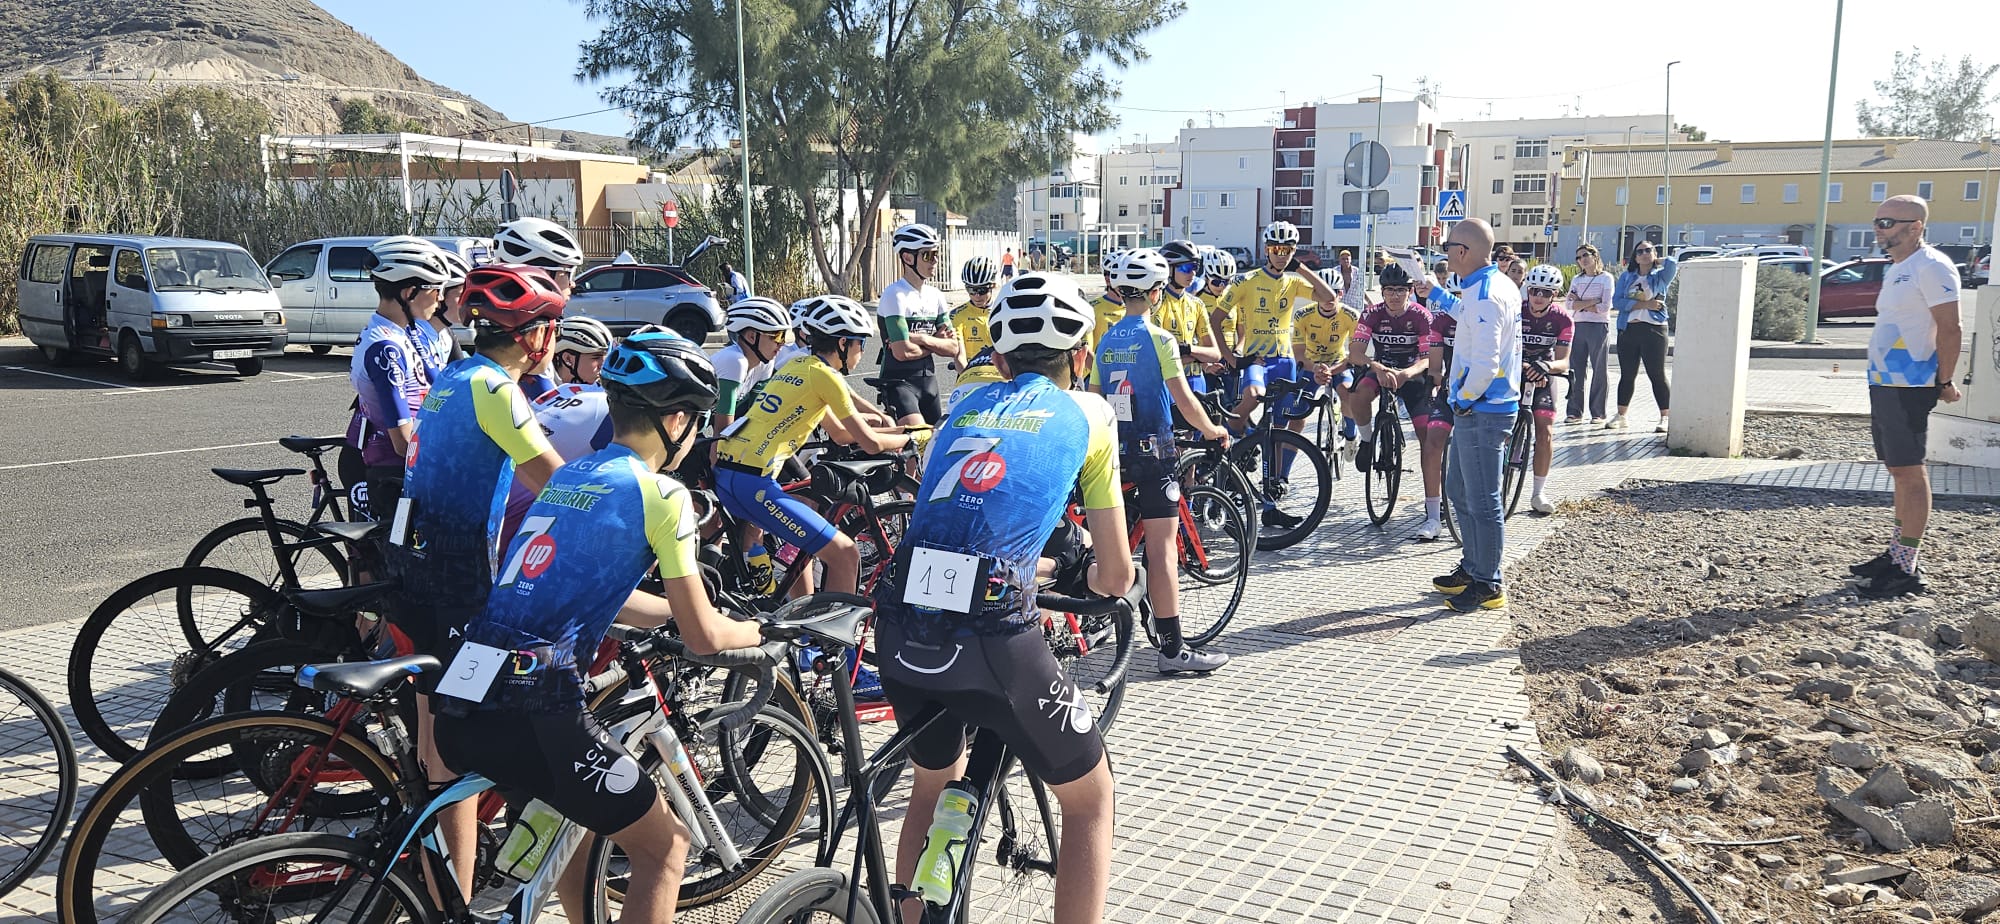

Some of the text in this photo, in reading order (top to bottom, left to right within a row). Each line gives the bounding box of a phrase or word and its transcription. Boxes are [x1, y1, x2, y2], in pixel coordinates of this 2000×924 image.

[1111, 327, 1138, 337] ACIC
[1378, 335, 1407, 344] TARO
[546, 396, 583, 410] TOP
[755, 440, 770, 457] Islas
[766, 413, 798, 440] Canarias
[568, 460, 614, 472] ACIC
[929, 437, 1003, 502] 7
[959, 495, 984, 505] ZERO
[763, 499, 807, 538] cajasiete
[499, 516, 556, 587] 7
[517, 581, 535, 591] ZERO
[919, 564, 958, 595] 19
[459, 659, 479, 681] 3
[859, 711, 888, 720] BH
[574, 731, 609, 772] ACIC
[286, 865, 345, 883] BH
